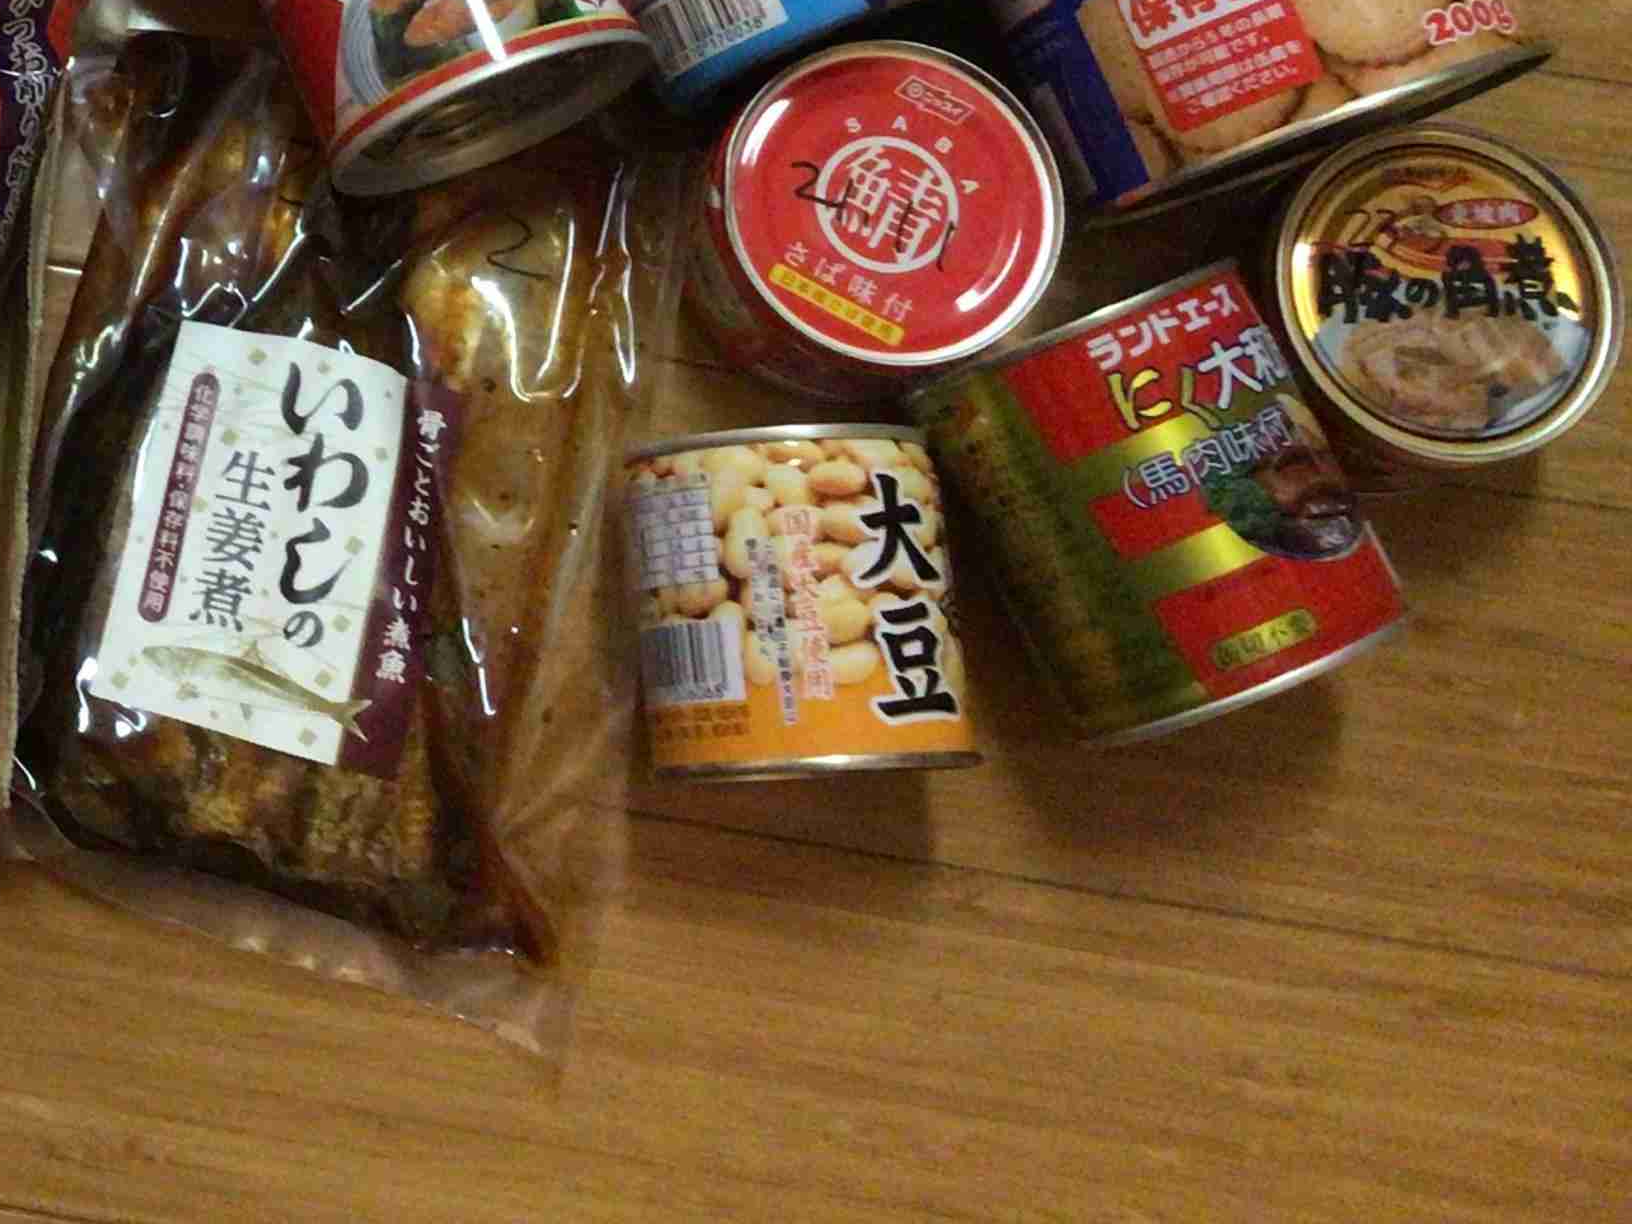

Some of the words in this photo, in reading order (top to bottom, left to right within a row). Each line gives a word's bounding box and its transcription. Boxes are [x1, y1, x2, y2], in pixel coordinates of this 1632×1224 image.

[782, 240, 914, 323] さば味付
[1085, 283, 1242, 371] ランドエース
[188, 450, 277, 634] 生姜煮
[279, 361, 371, 649] いわしの
[374, 408, 451, 686] 骨ごとおいしい煮魚
[857, 471, 959, 719] 大豆
